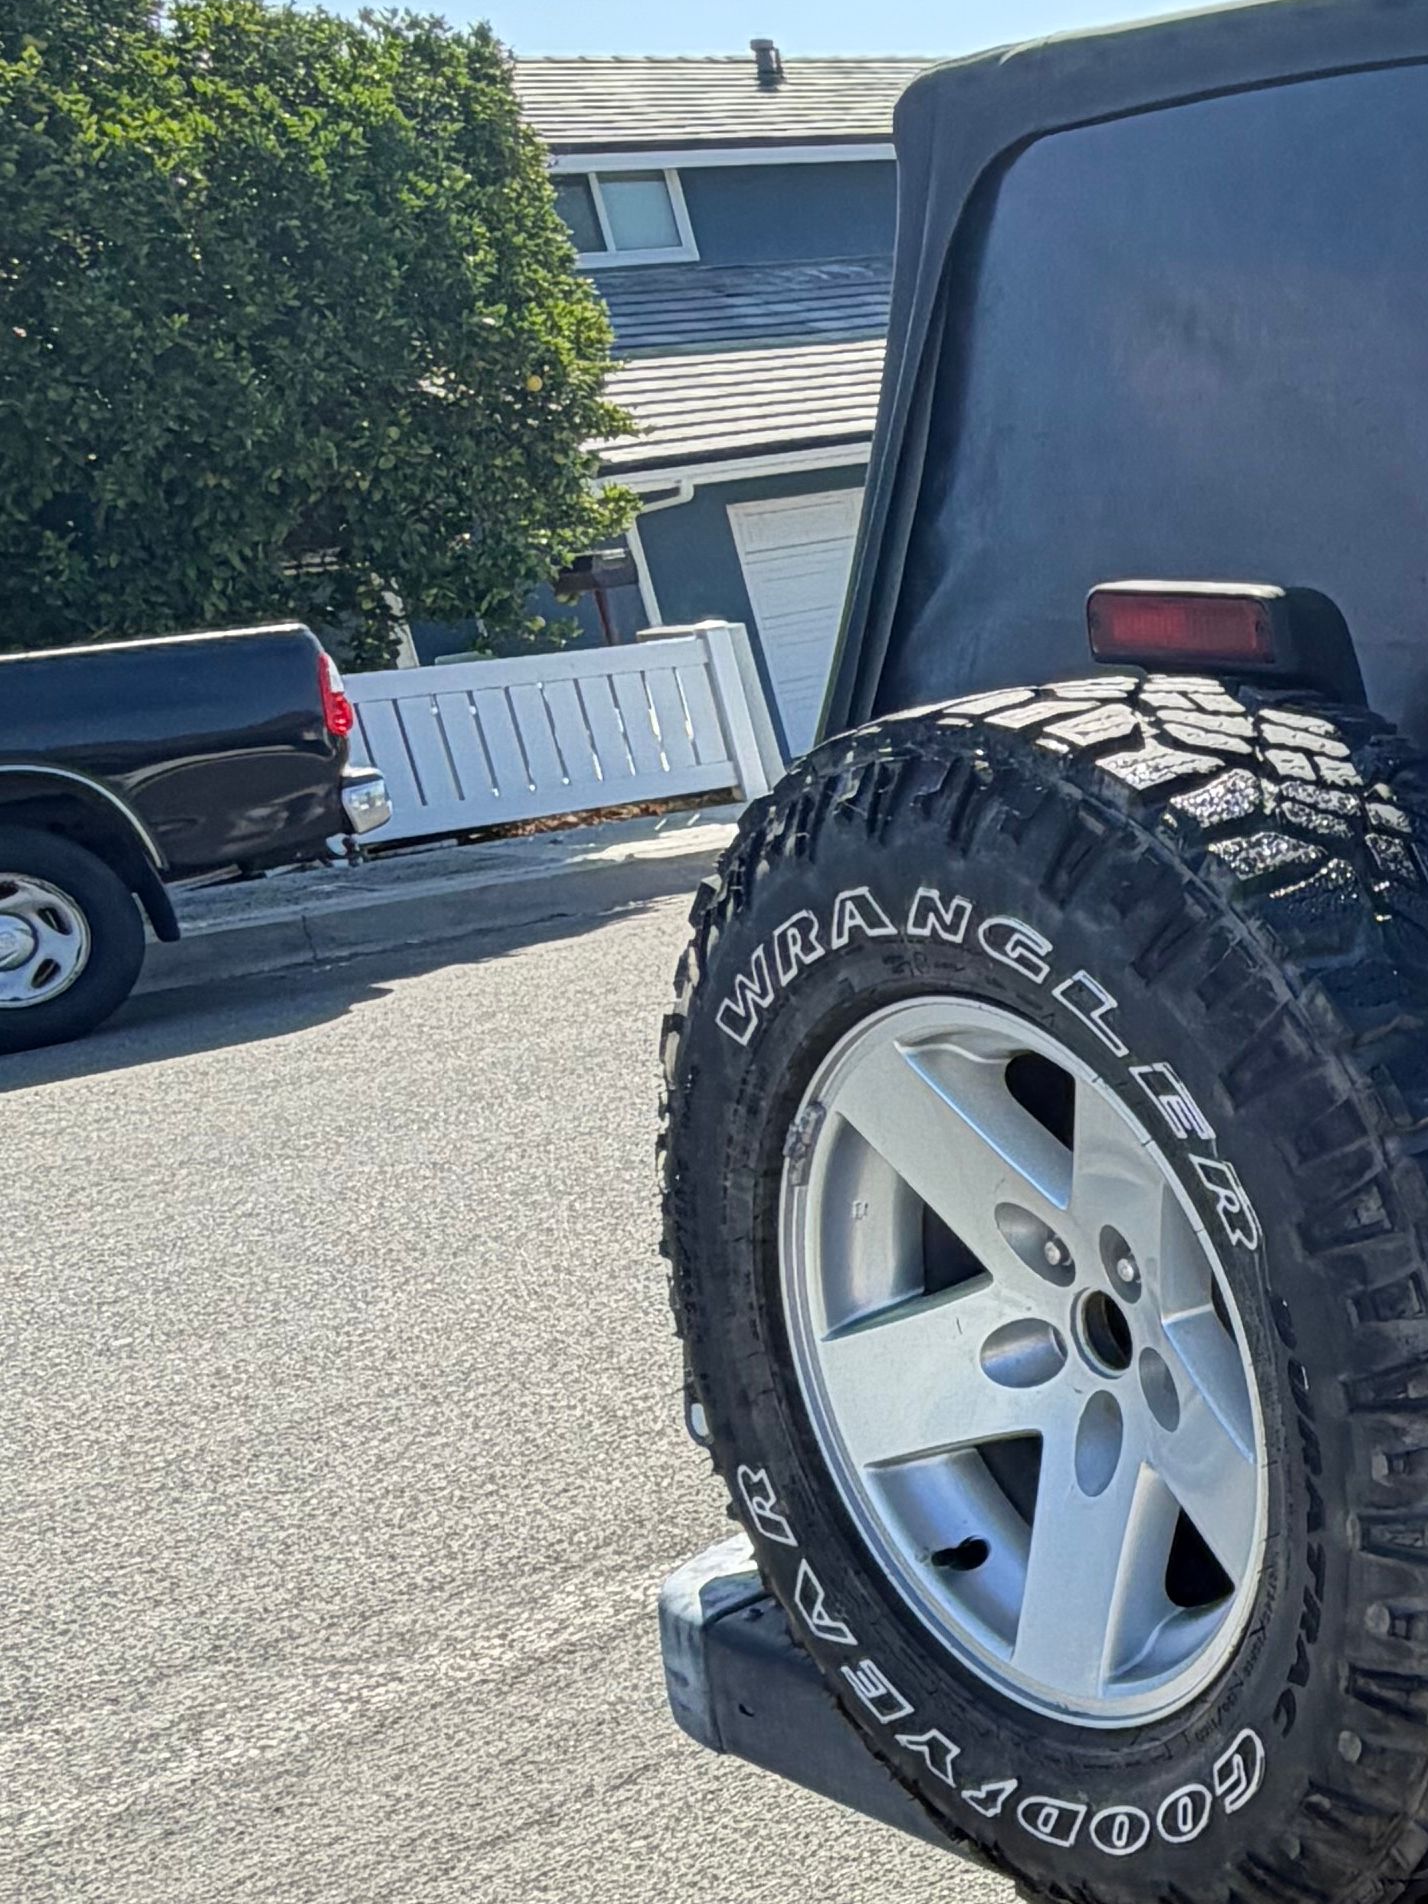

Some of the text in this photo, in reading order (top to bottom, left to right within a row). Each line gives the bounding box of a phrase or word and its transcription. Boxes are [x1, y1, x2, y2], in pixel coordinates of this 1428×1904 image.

[715, 886, 1261, 1252] WRANGLER
[736, 1464, 1266, 1856] GOODYEAR
[1267, 1289, 1327, 1740] DURATRAC
